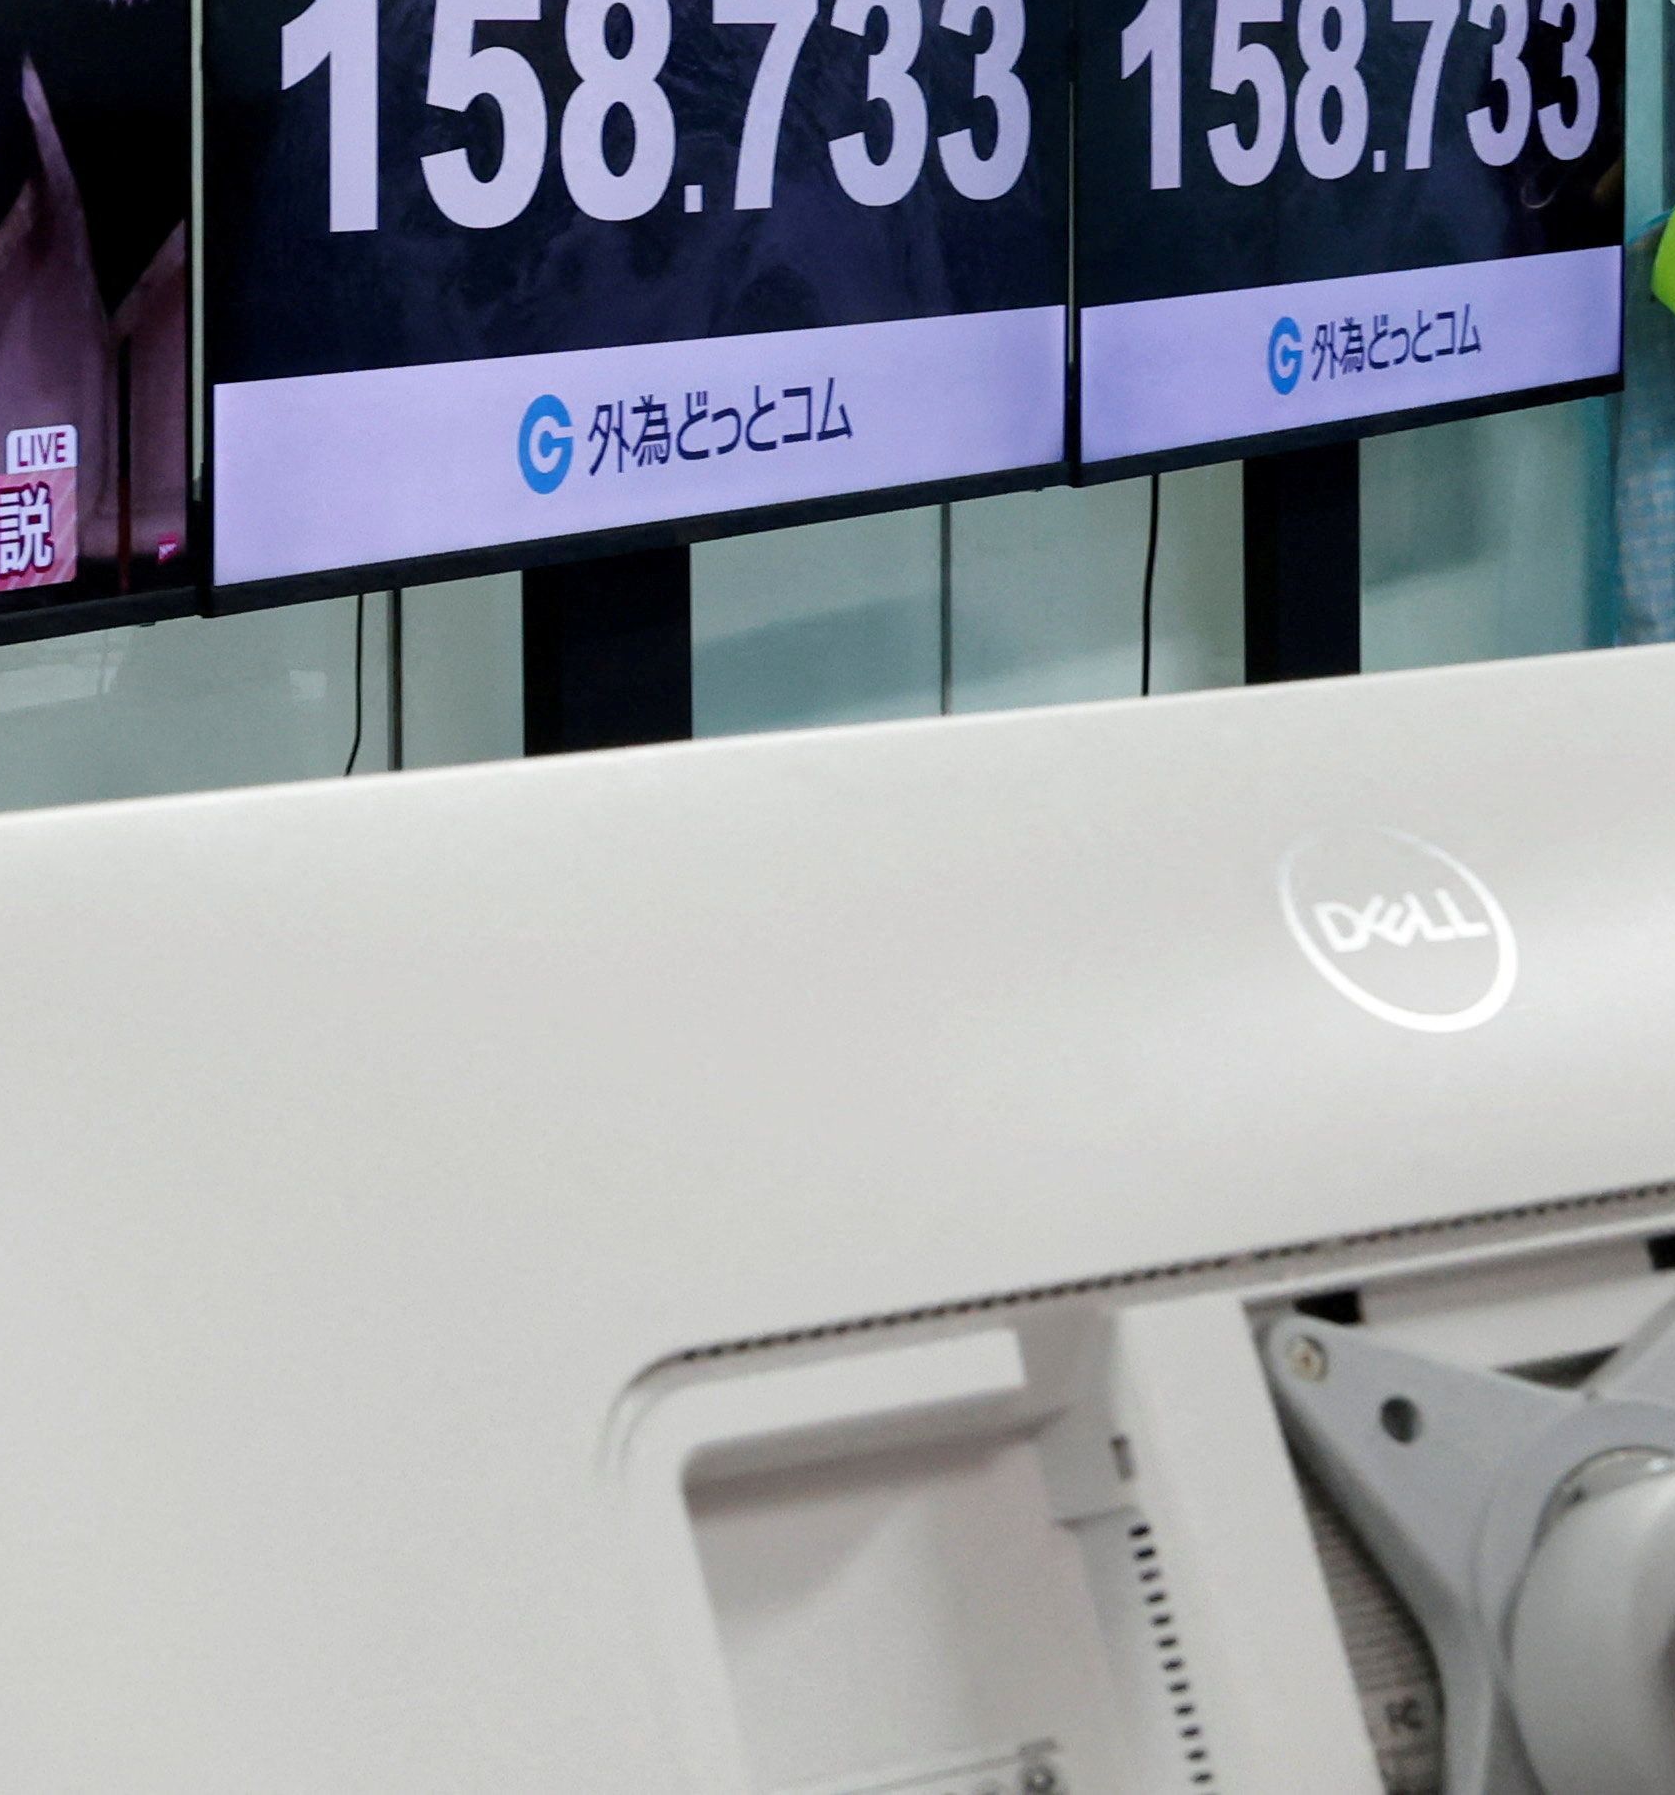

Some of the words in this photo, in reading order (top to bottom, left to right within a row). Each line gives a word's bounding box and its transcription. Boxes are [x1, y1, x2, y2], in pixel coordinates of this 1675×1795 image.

[1311, 304, 1483, 381] 外為どっとコム
[17, 431, 67, 468] LIVE
[587, 377, 854, 476] 外為どっとコム
[1313, 887, 1490, 954] DELL
